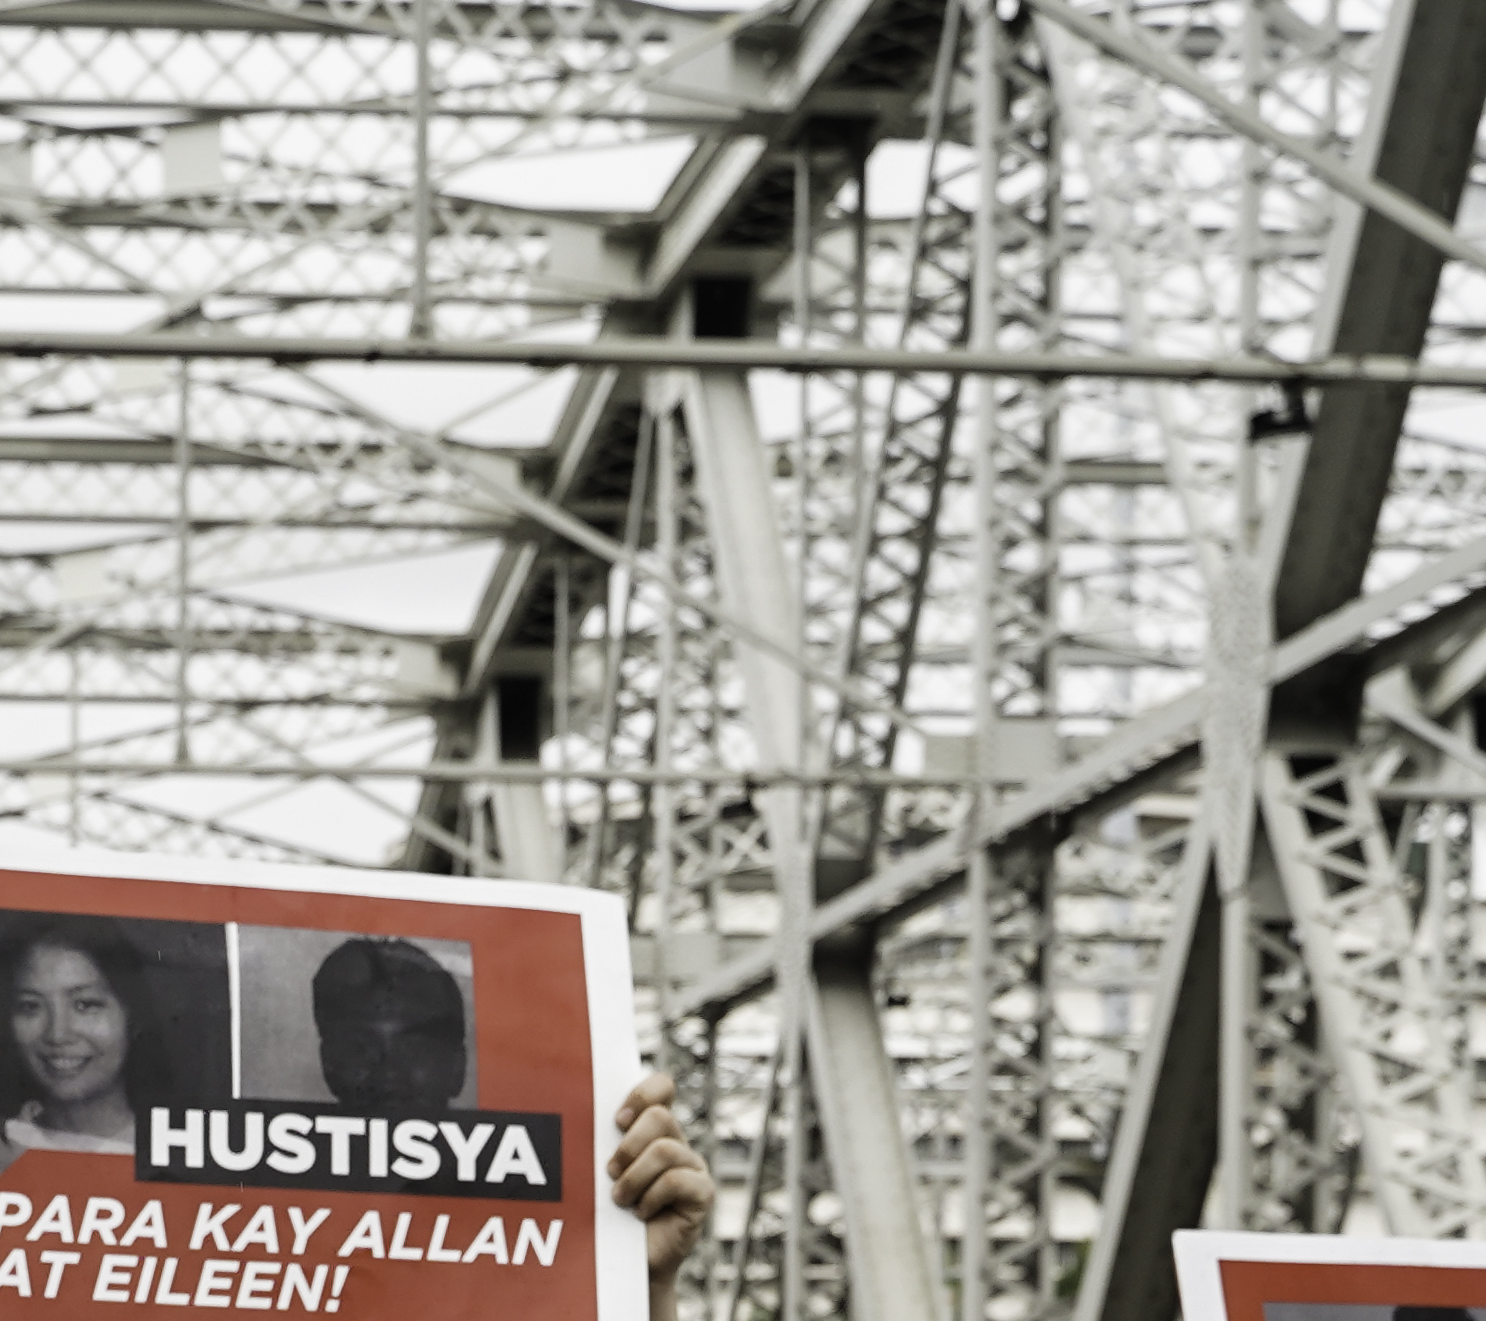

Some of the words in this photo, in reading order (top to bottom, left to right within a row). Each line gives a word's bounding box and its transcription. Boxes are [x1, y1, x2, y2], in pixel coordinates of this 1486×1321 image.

[151, 1106, 547, 1185] HUSTISYA
[189, 1202, 331, 1256] KAY
[338, 1210, 563, 1266] ALLAN
[92, 1255, 350, 1313] EILEEN!
